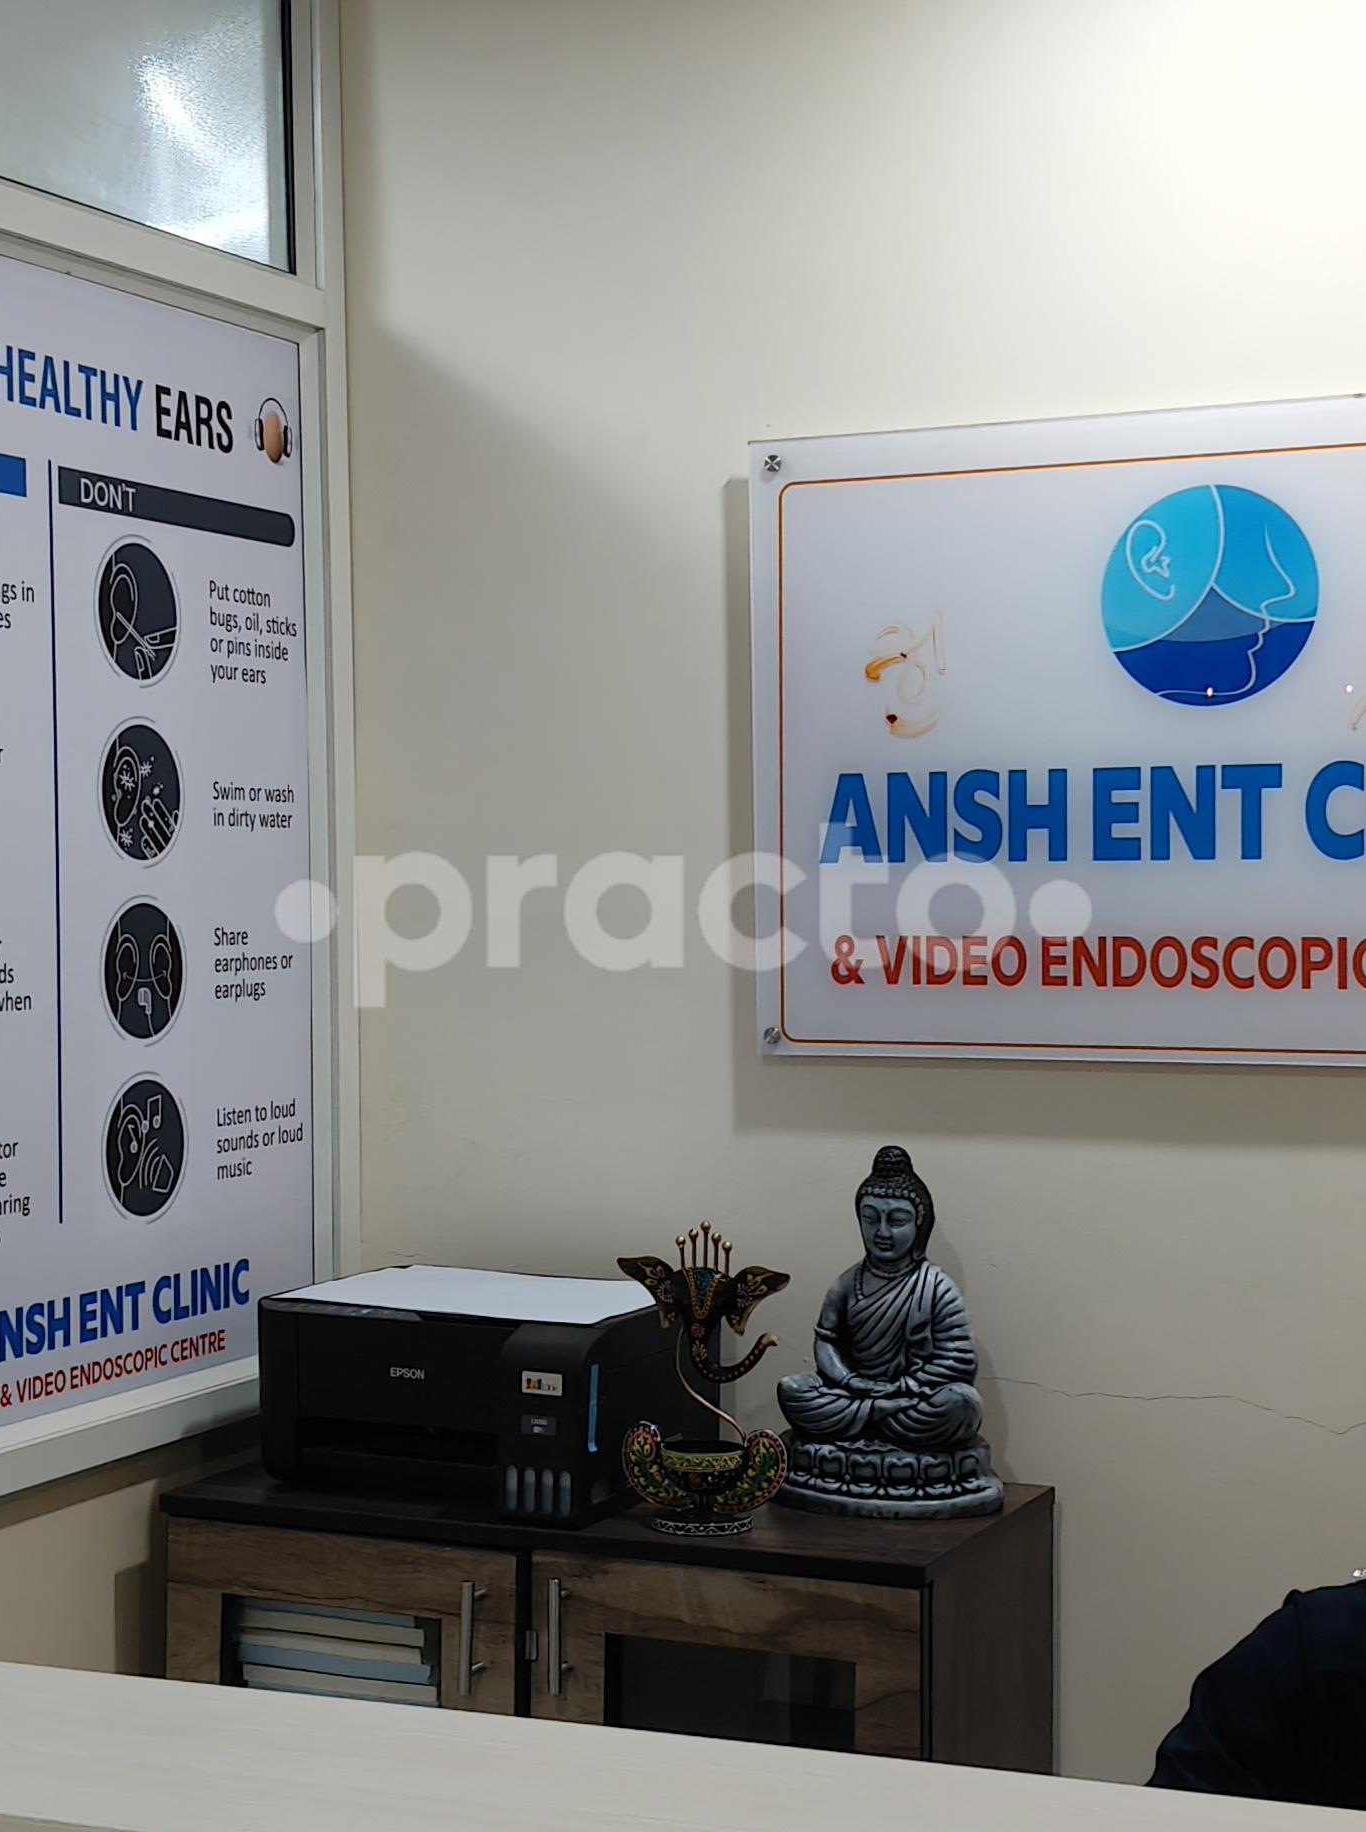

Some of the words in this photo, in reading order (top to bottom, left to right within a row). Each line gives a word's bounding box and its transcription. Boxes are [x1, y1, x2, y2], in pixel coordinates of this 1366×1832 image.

[154, 383, 234, 454] EARS
[21, 586, 35, 603] in
[209, 579, 230, 602] Put
[232, 587, 271, 609] cotton
[209, 605, 242, 633] bugs,
[244, 612, 263, 636] oil,
[265, 616, 298, 638] sticks
[209, 637, 224, 653] or
[226, 639, 252, 659] pins
[254, 638, 289, 662] inside
[210, 664, 239, 684] your
[241, 667, 267, 685] ears
[212, 780, 246, 801] Swim
[248, 787, 263, 802] or
[264, 783, 295, 803] wash
[212, 807, 225, 827] in
[227, 807, 257, 833] dirty
[258, 811, 293, 829] water
[819, 768, 1070, 865] ANSH
[1092, 763, 1283, 862] ENT
[213, 926, 249, 947] Share
[214, 951, 278, 977] earphones
[280, 954, 294, 970] or
[830, 936, 864, 987] &
[875, 934, 1029, 988] VIDEO
[214, 978, 266, 1003] earplugs
[216, 1107, 252, 1128] Listen
[254, 1105, 268, 1123] to
[270, 1097, 296, 1121] loud
[216, 1129, 260, 1155] sounds
[262, 1131, 276, 1147] or
[278, 1122, 304, 1145] loud
[217, 1160, 253, 1181] music
[79, 1280, 146, 1344] ENT
[152, 1258, 250, 1325] CLINIC
[0, 1383, 13, 1408] &
[16, 1369, 67, 1404] VIDEO
[69, 1343, 168, 1390] ENDOSCOPIC
[170, 1328, 226, 1363] CENTRE
[390, 1367, 425, 1379] EPSON
